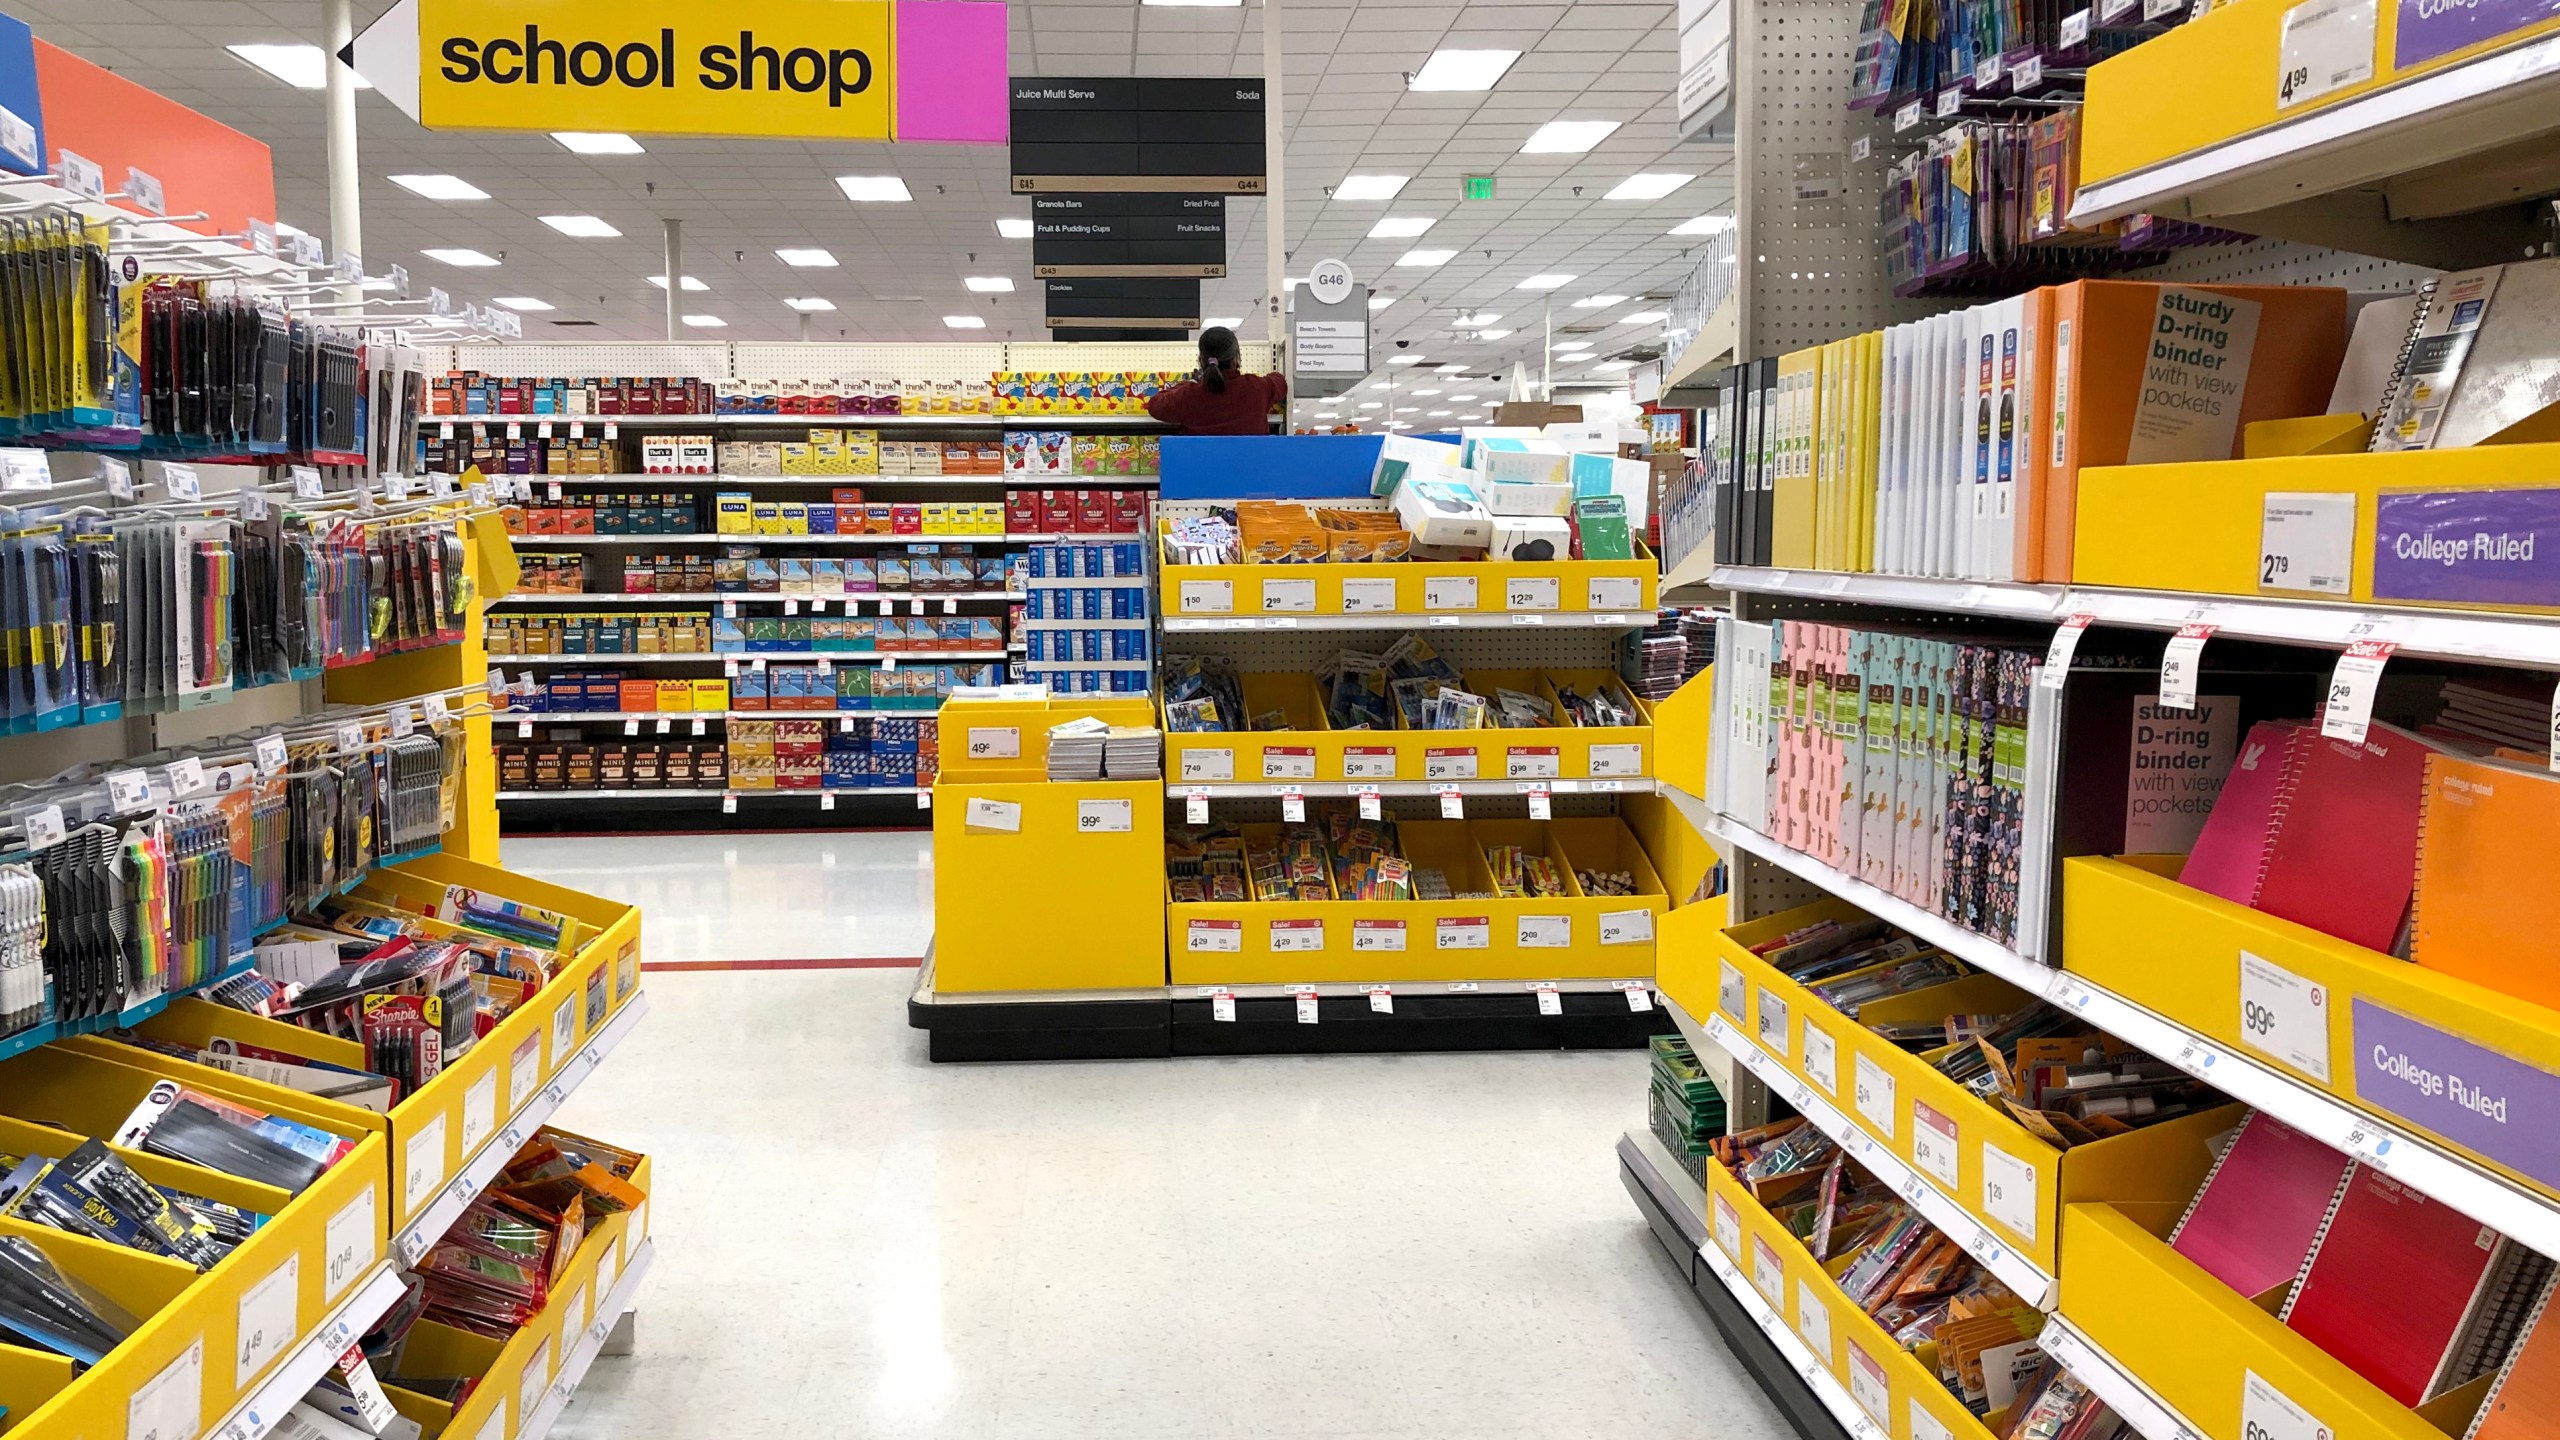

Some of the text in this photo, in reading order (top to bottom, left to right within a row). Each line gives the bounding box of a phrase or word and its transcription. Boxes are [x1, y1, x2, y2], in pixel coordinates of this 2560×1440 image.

[441, 24, 873, 107] school shop
[2281, 67, 2307, 102] 499
[1016, 89, 1095, 99] Juice Multi Serve
[1235, 90, 1260, 100] Soda
[1019, 179, 1035, 189] G45
[1238, 180, 1258, 190] G44
[1037, 200, 1083, 209] Granola Bars
[1183, 200, 1220, 208] Dried Fruit
[1038, 224, 1053, 233] Fruit
[1062, 224, 1089, 235] Pudding
[1091, 224, 1110, 235] Cups
[1177, 223, 1220, 232] Fruit Snacks
[1041, 267, 1057, 275] G43
[1204, 266, 1219, 275] G42
[1318, 274, 1344, 286] G46
[1050, 284, 1073, 292] Cookies
[2162, 293, 2235, 324] sturdy
[2158, 314, 2229, 349] D-ring
[1300, 343, 1315, 351] Body
[2153, 339, 2227, 370] binder
[1313, 360, 1325, 368] Toys
[720, 382, 742, 390] think!
[751, 382, 773, 390] think!
[782, 382, 804, 390] think!
[813, 382, 834, 390] think!
[844, 382, 865, 390] think!
[874, 382, 896, 390] think!
[2150, 365, 2238, 396] with view
[905, 383, 927, 391] think!
[936, 383, 957, 391] think!
[966, 383, 988, 391] think!
[2143, 388, 2222, 416] pockets
[2396, 531, 2534, 567] College Ruled
[2264, 553, 2288, 585] 279
[1428, 593, 1439, 604] $1
[1592, 593, 1602, 604] $1
[2063, 615, 2086, 627] Sale!
[2177, 625, 2205, 637] Sale!
[2350, 623, 2374, 635] 2.79
[2347, 641, 2384, 657] Sale!
[2331, 685, 2351, 702] 249
[2139, 703, 2212, 726] sturdy
[2138, 727, 2210, 749] D-ring
[1266, 747, 1283, 755] Sale!
[1345, 747, 1363, 755] Sale!
[1428, 748, 1445, 756] Sale!
[1509, 747, 1527, 755] Sale!
[2364, 740, 2389, 757] ruled
[2136, 751, 2211, 770] binder
[2134, 773, 2225, 791] with view
[2444, 775, 2493, 796] college ruled
[2132, 795, 2212, 816] pockets
[1191, 920, 1209, 928] Sale!
[1272, 921, 1291, 929] Sale!
[1355, 920, 1374, 928] Sale!
[1438, 918, 1457, 926] Sale!
[366, 995, 386, 1009] NEW
[366, 1007, 419, 1025] Sharpie
[2246, 999, 2275, 1036] 99¢
[2372, 1045, 2506, 1124] College Ruled
[2345, 1130, 2365, 1144] .99
[2372, 1171, 2425, 1204] college ruled
[325, 1333, 343, 1352] 10.49
[338, 1344, 359, 1374] Sale!
[2064, 1406, 2075, 1417] 40
